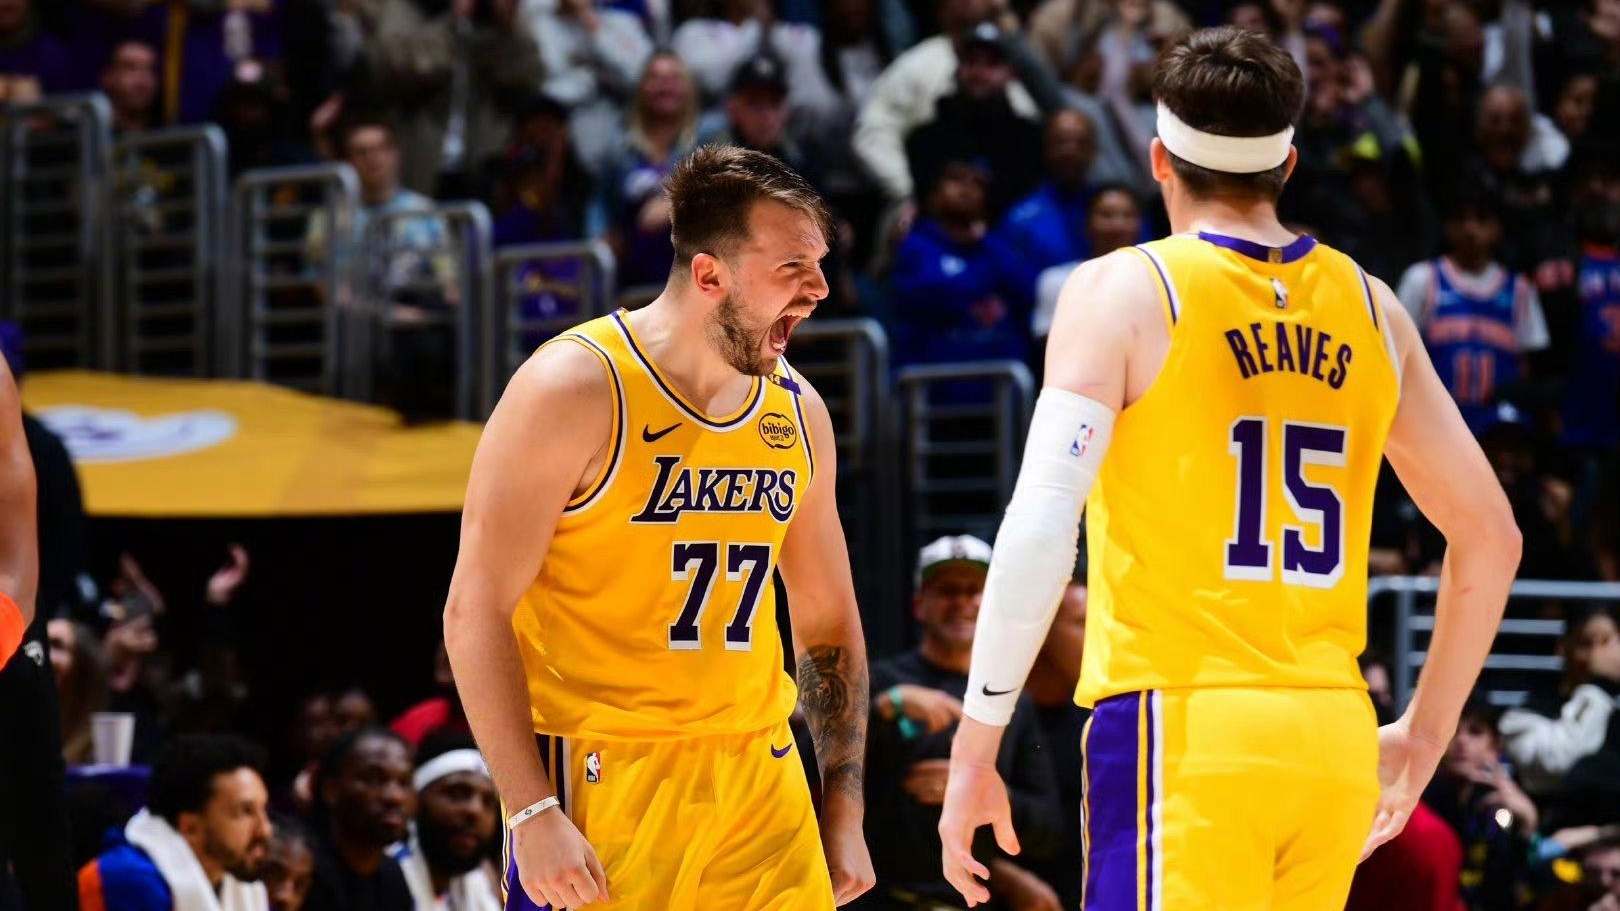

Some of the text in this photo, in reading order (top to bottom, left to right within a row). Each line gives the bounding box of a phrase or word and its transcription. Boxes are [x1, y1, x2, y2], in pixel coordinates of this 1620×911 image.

[1225, 322, 1352, 390] REAVES
[762, 422, 794, 439] bibigo
[630, 455, 796, 523] LAKERS
[1223, 415, 1348, 589] 15
[668, 541, 772, 651] 77
